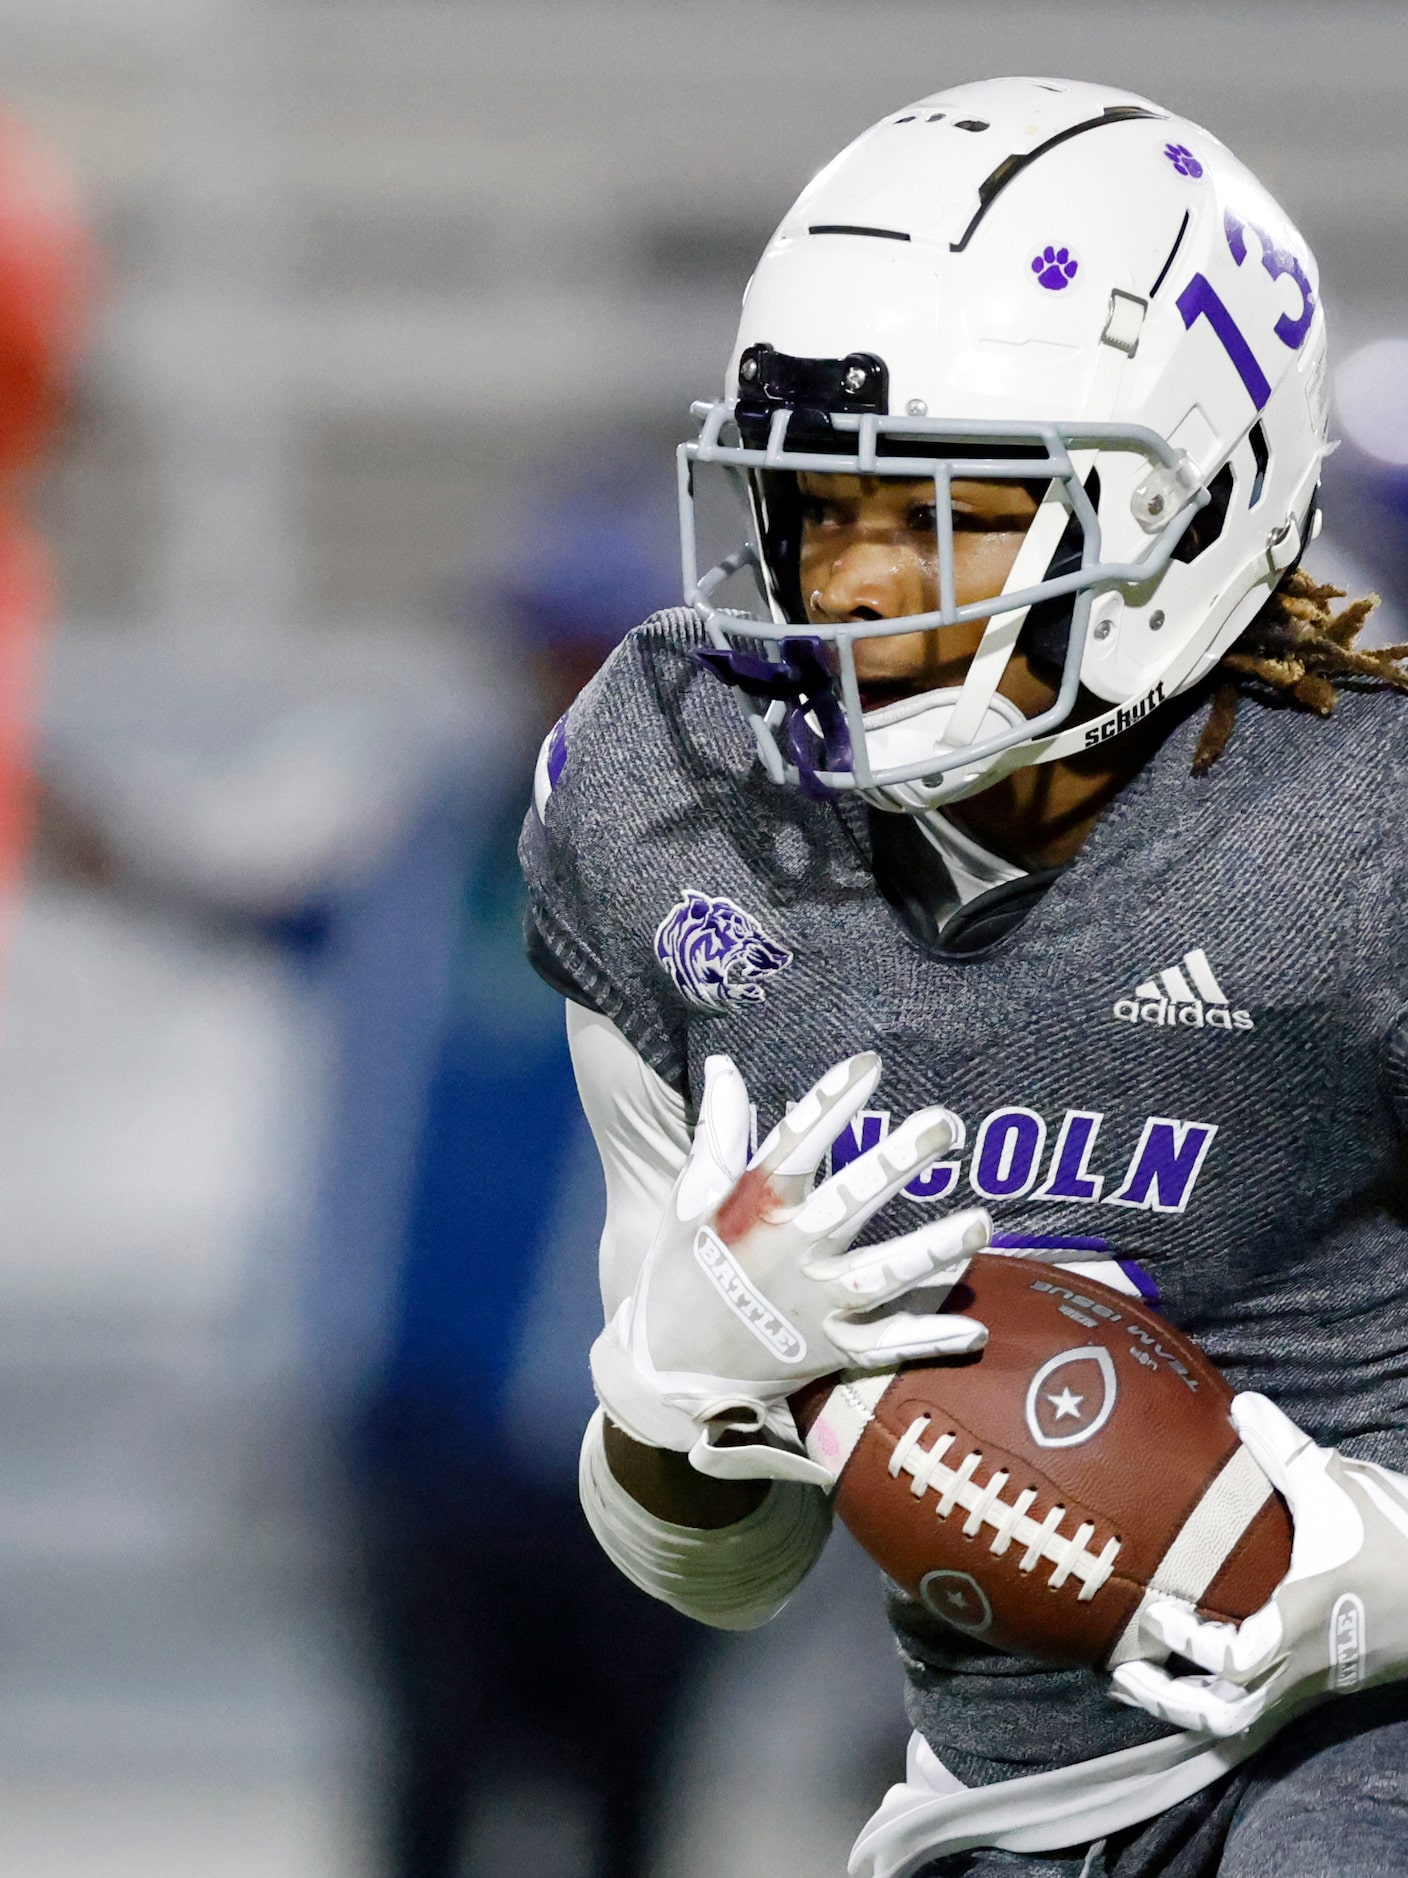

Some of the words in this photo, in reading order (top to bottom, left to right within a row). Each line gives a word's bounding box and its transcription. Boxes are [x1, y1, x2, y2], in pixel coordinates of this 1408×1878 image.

[1175, 206, 1317, 412] 13
[1085, 679, 1166, 748] schutt
[1112, 998, 1255, 1031] adidas
[699, 1237, 798, 1355] BATTLE
[1126, 1324, 1200, 1393] TEAM
